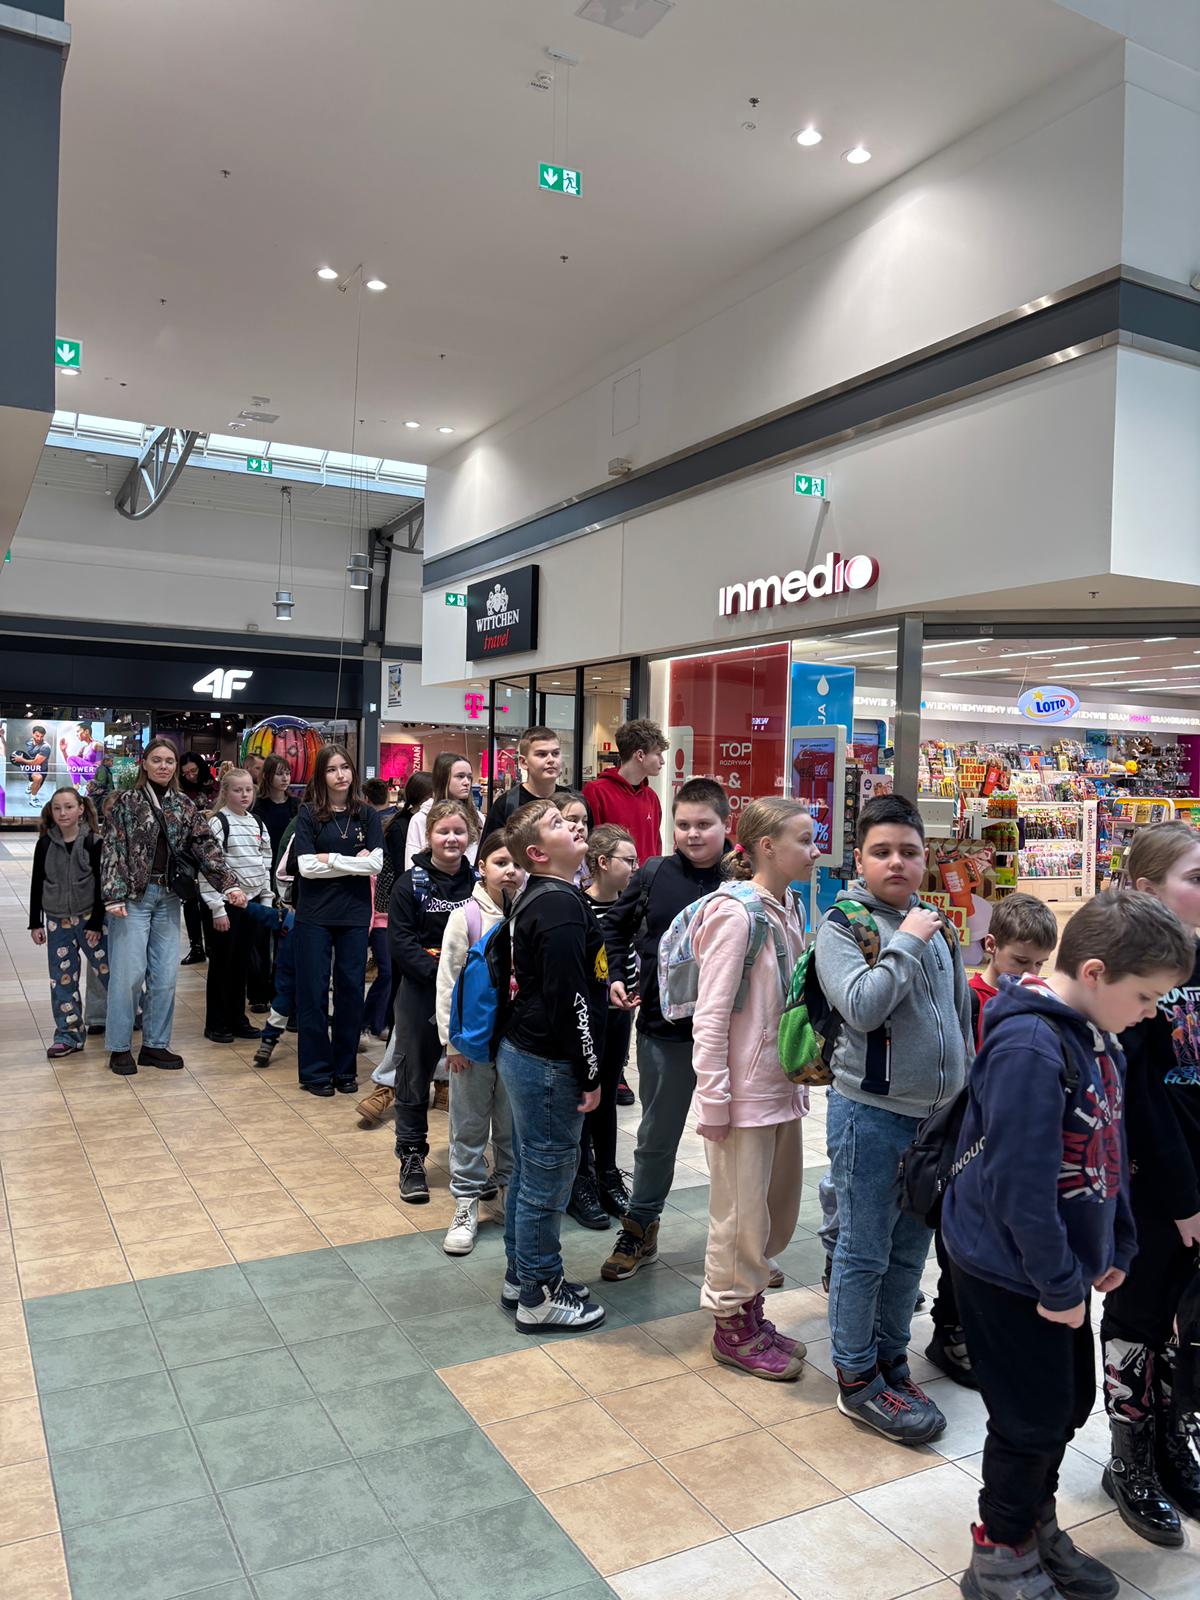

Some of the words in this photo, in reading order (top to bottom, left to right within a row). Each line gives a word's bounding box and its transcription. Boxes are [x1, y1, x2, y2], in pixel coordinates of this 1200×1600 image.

[476, 608, 520, 632] WITTCHEN
[483, 628, 510, 650] travel
[192, 667, 254, 699] 4F
[1036, 699, 1066, 713] LOTTO
[412, 746, 422, 774] OZNAŃ
[719, 743, 752, 758] TOP
[728, 772, 742, 789] &
[729, 795, 751, 810] OP
